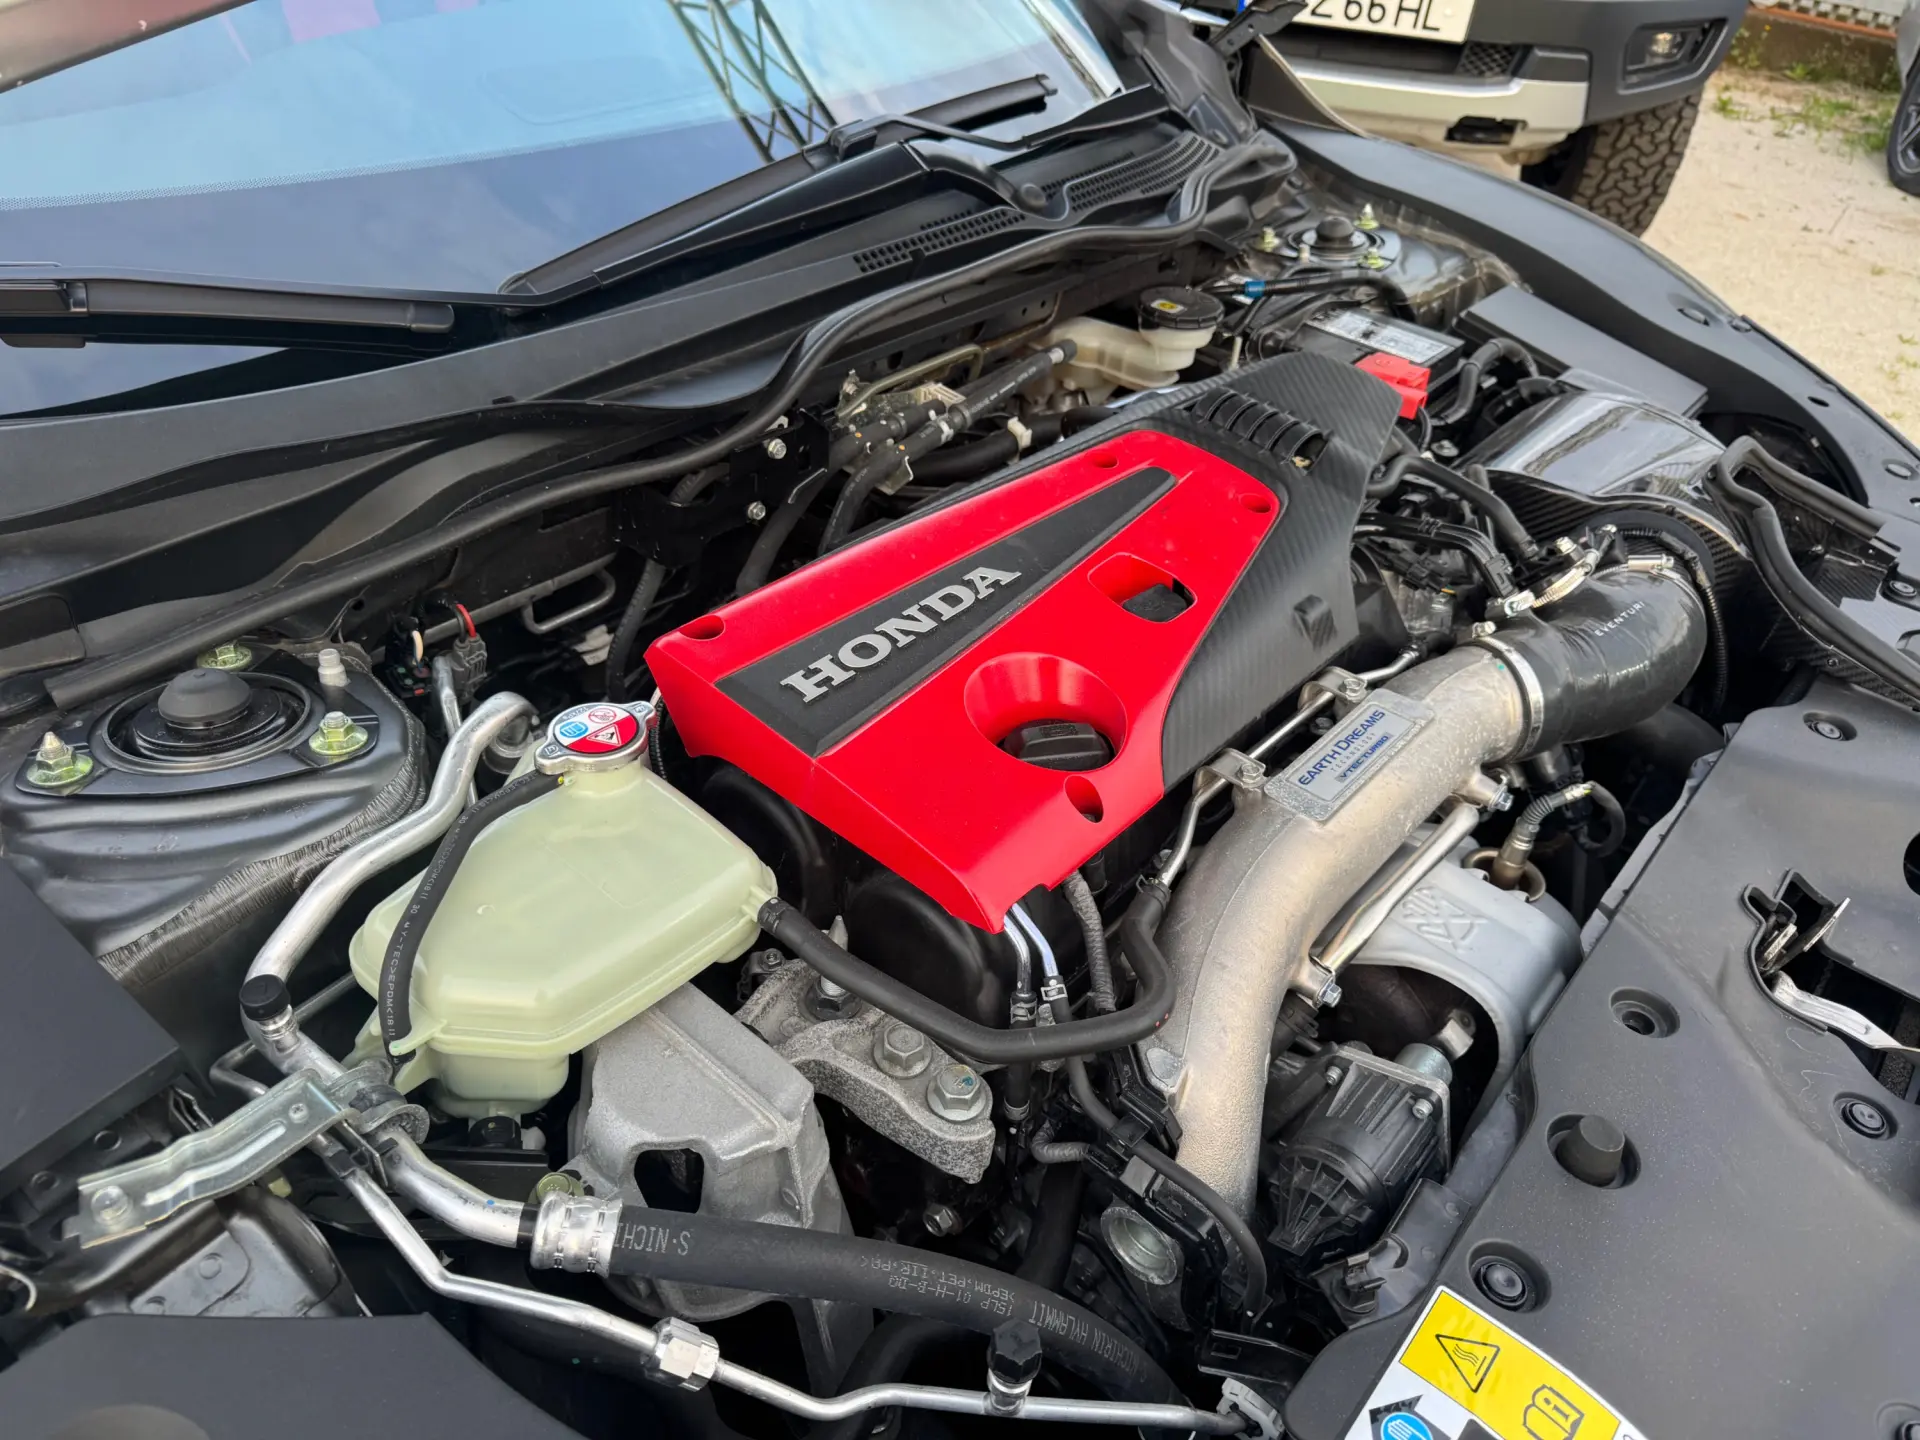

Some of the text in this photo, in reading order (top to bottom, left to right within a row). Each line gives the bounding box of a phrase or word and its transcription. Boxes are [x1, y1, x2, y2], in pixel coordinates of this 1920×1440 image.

[780, 567, 1023, 704] HONDA
[1594, 601, 1645, 637] EVENTURI
[1298, 710, 1385, 785] EARTH DREAMS
